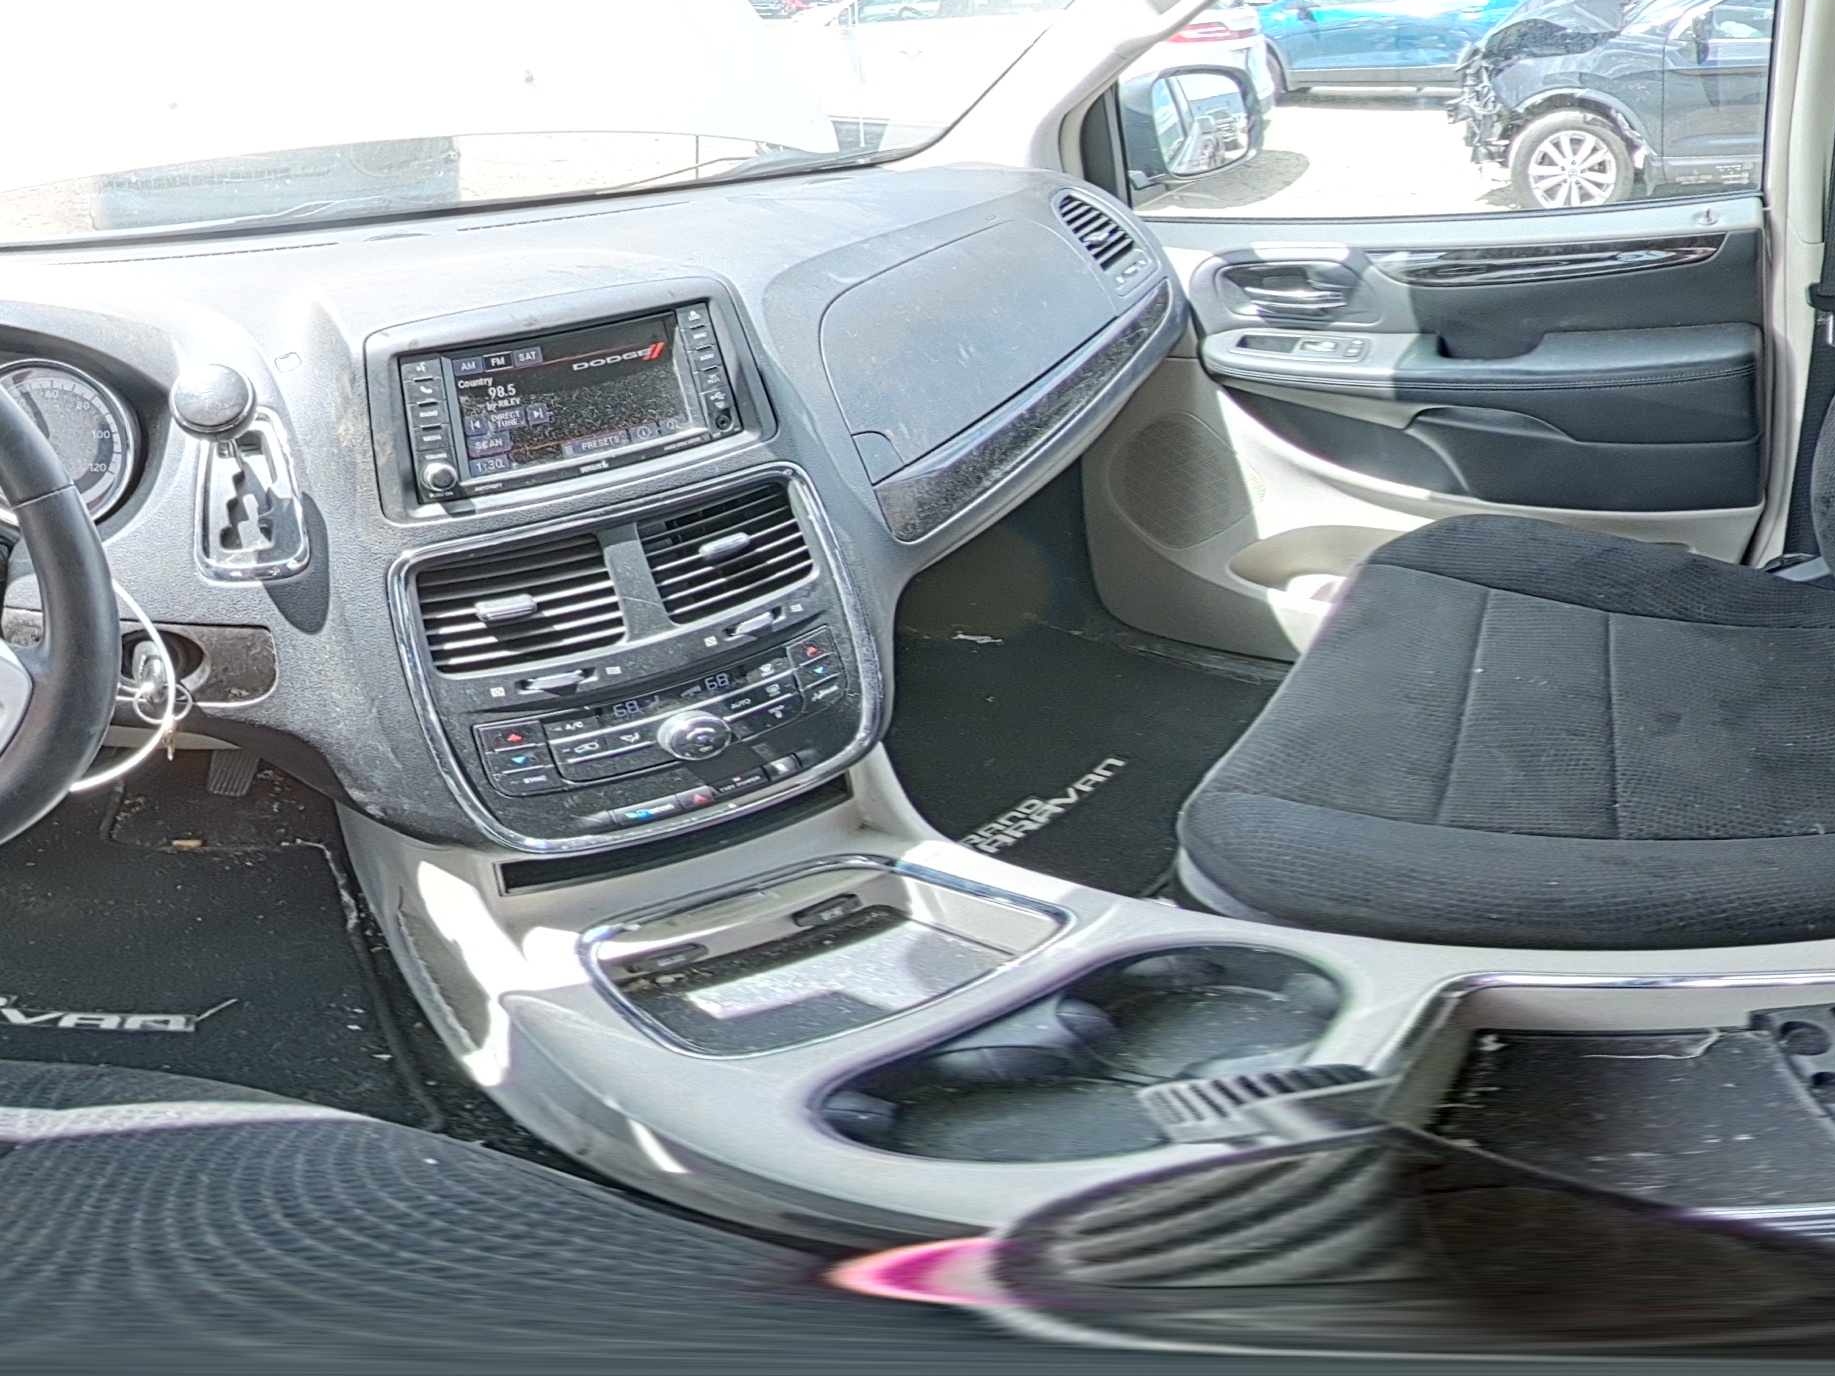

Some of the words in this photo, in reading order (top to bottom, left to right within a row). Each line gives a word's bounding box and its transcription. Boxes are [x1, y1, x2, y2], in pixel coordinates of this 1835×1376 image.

[461, 362, 476, 371] AM
[490, 357, 505, 366] FM
[518, 351, 536, 362] SAT
[572, 348, 654, 371] DODGE
[458, 377, 493, 389] Country
[44, 389, 59, 398] 60
[488, 384, 516, 399] 98.5
[76, 401, 91, 410] 80
[490, 410, 521, 422] DIRECT
[92, 430, 110, 439] 100
[475, 439, 503, 450] SCAN
[581, 436, 621, 451] PRESETS
[89, 463, 107, 472] 120
[705, 673, 729, 691] 68
[731, 698, 751, 709] AUTO
[565, 720, 583, 731] A/C
[977, 758, 1128, 853] ARAVAN
[958, 799, 1044, 846] RAND
